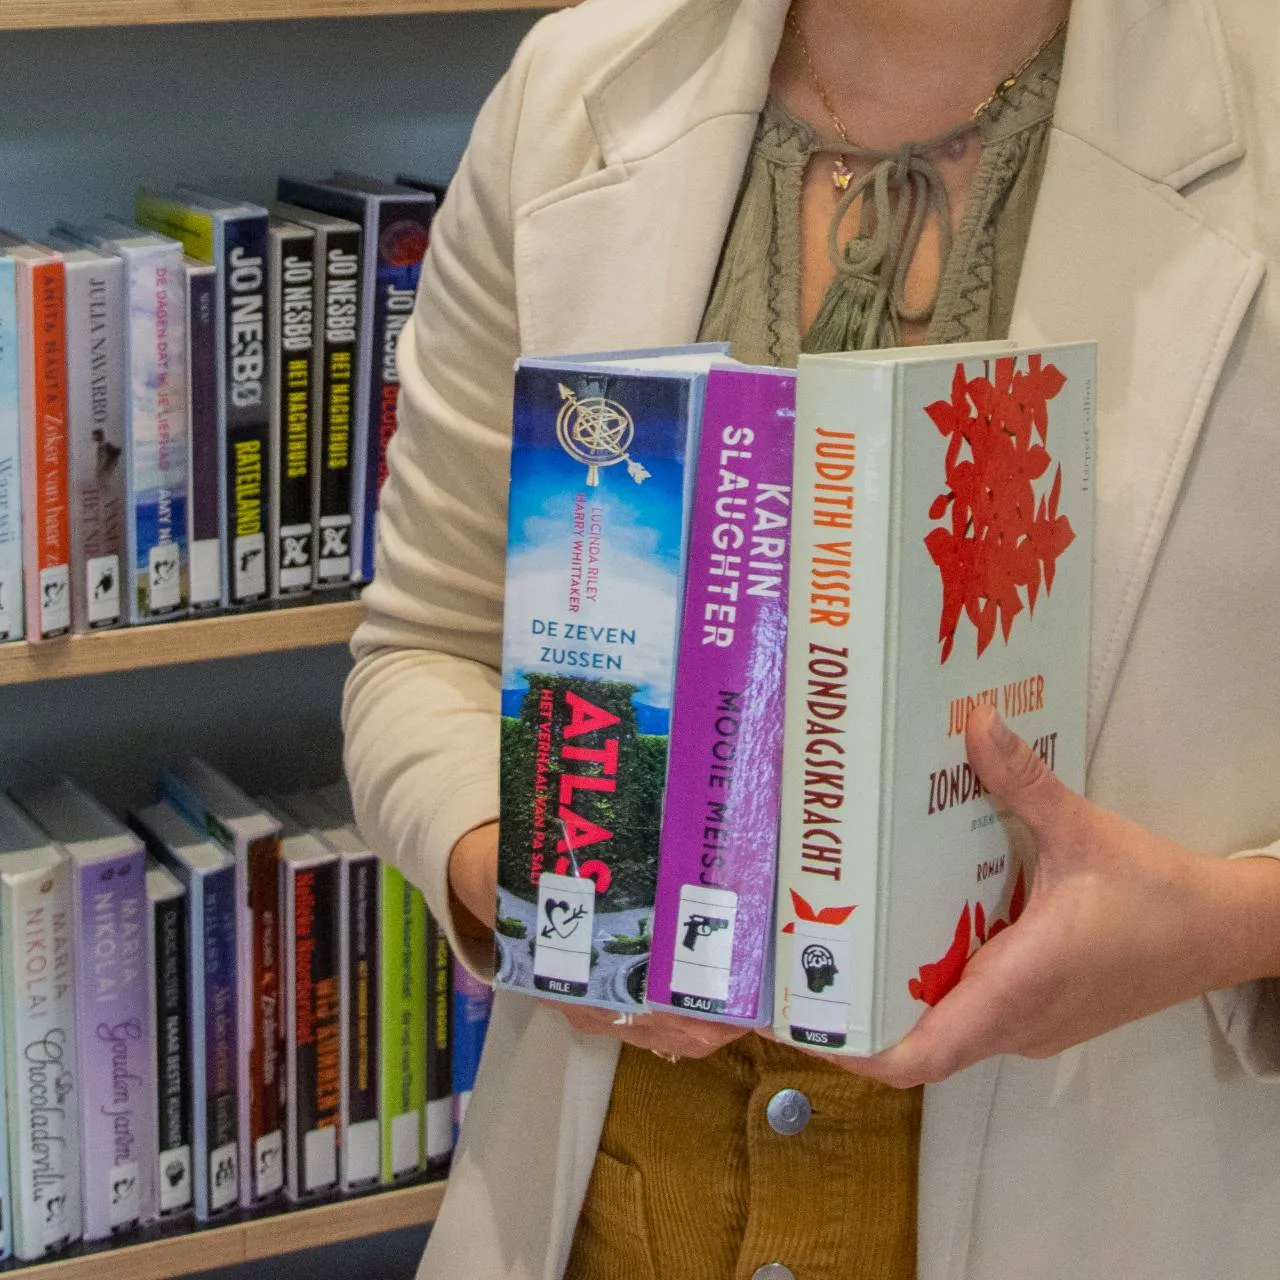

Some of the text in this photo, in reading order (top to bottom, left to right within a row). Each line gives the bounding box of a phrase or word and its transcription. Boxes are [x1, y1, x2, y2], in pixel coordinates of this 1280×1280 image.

[567, 494, 585, 613] HARRY WHITTAKER
[702, 425, 755, 647] SLAUGHTER
[745, 484, 791, 598] KARIN
[588, 507, 602, 603] LUCINDA RILEY
[532, 620, 637, 645] DE ZEVEN
[540, 647, 623, 670] ZUSSEN
[800, 426, 855, 881] JUDITH VISSER ZONDAGSKRACHT
[1004, 674, 1045, 718] VISSER
[977, 855, 1005, 882] ROMAN
[549, 979, 572, 993] RILE
[682, 996, 711, 1011] SLAU
[805, 1032, 828, 1043] VISS
